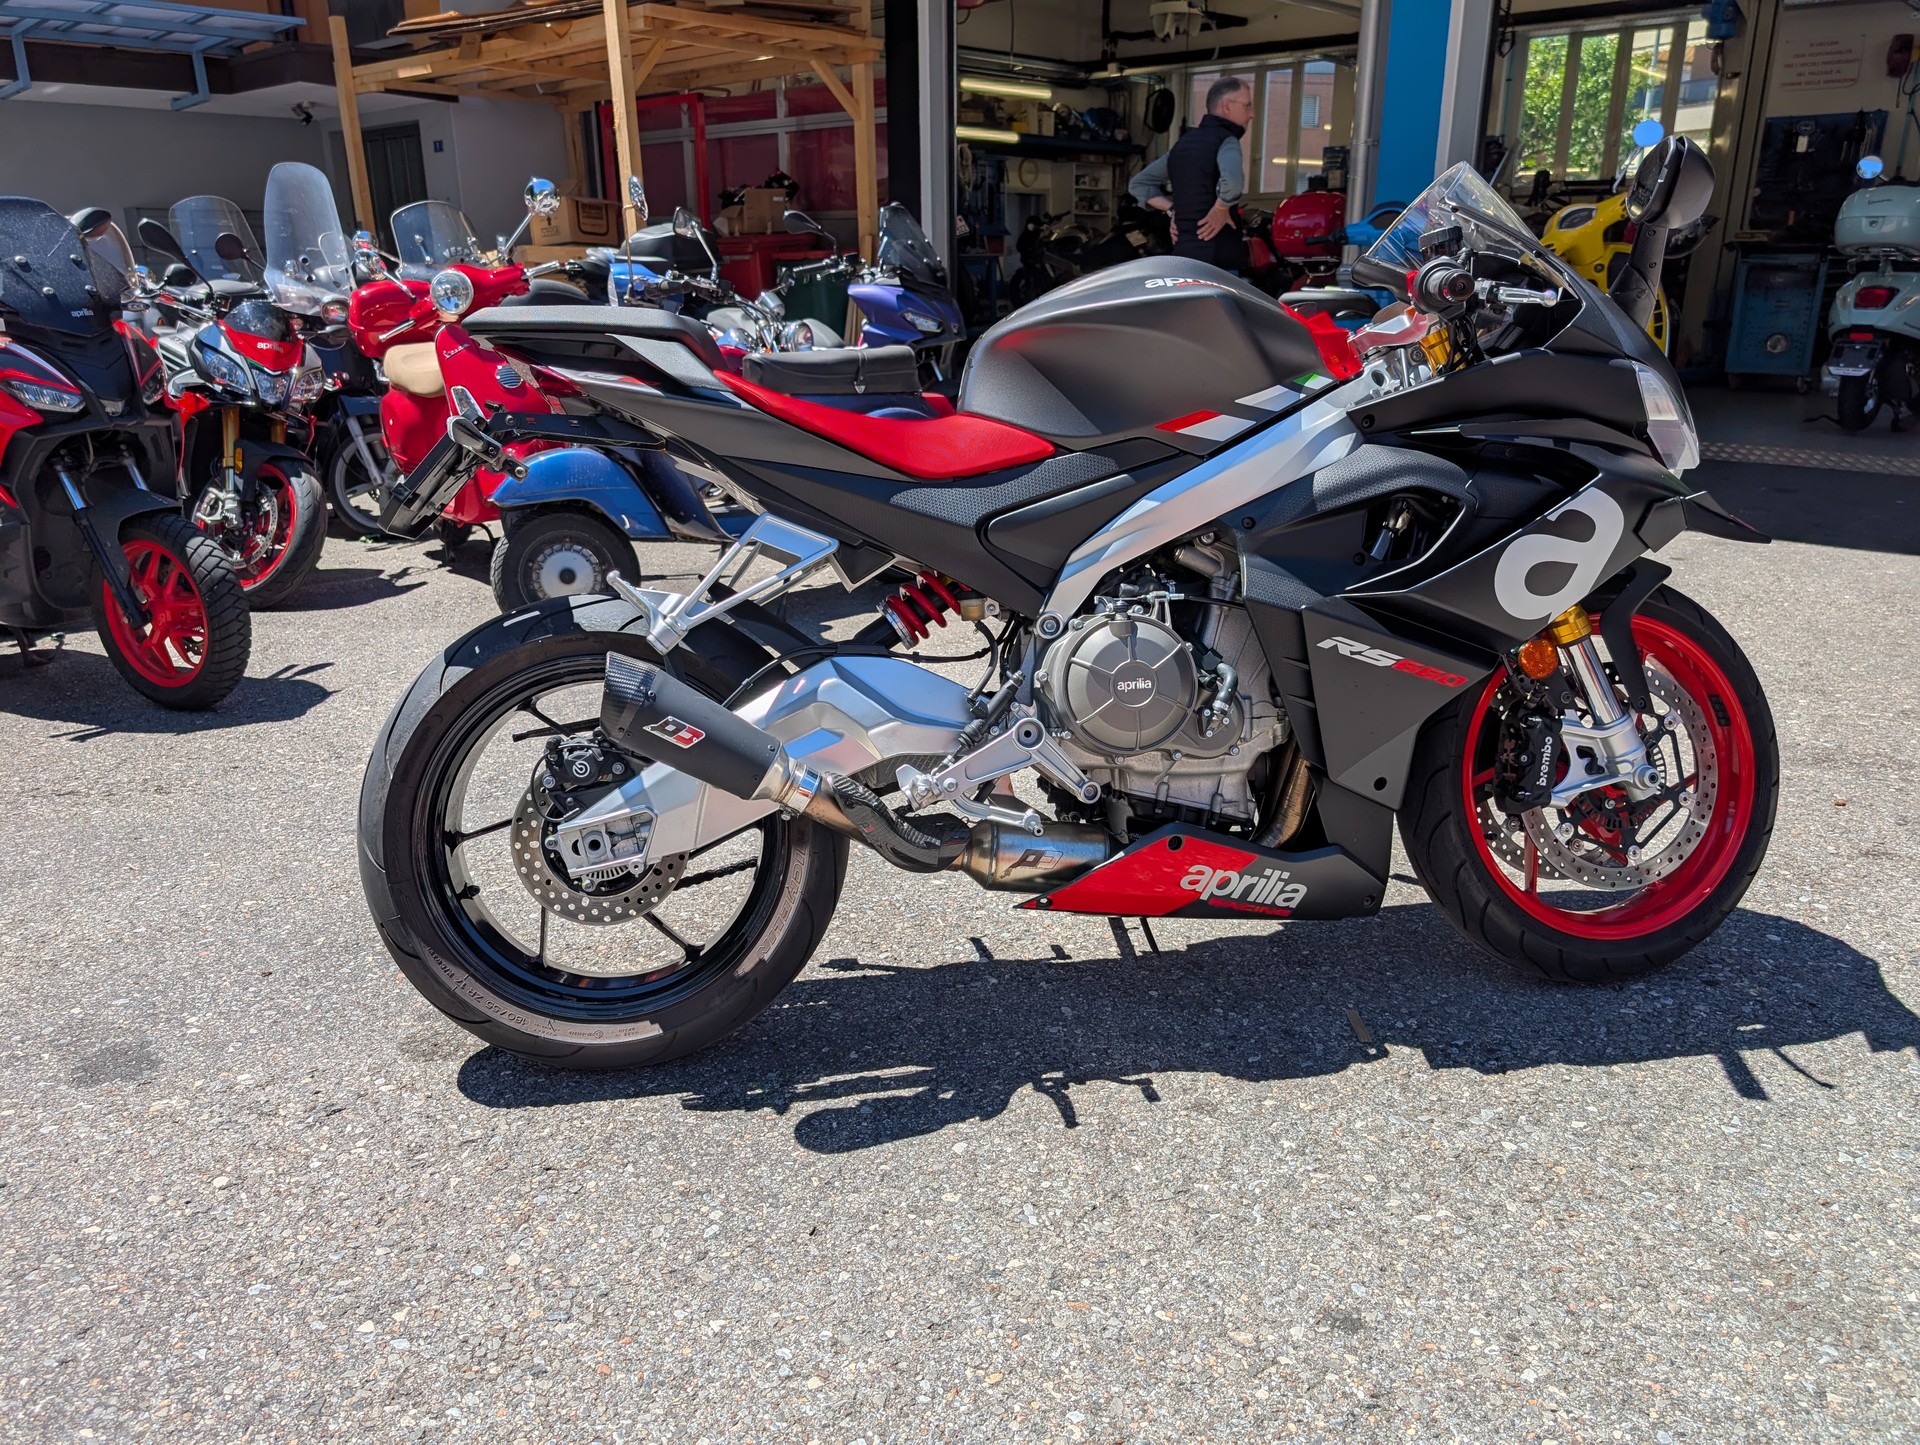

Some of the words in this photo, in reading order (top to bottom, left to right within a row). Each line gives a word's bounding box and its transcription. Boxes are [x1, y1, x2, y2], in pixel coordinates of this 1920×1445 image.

[443, 247, 472, 258] VESP
[1117, 677, 1152, 693] aprilia
[1536, 736, 1553, 786] brembo
[757, 845, 806, 955] ICHELIN
[1180, 865, 1308, 909] aprilia
[468, 987, 485, 1003] ZR
[485, 1001, 527, 1027] 180/55
